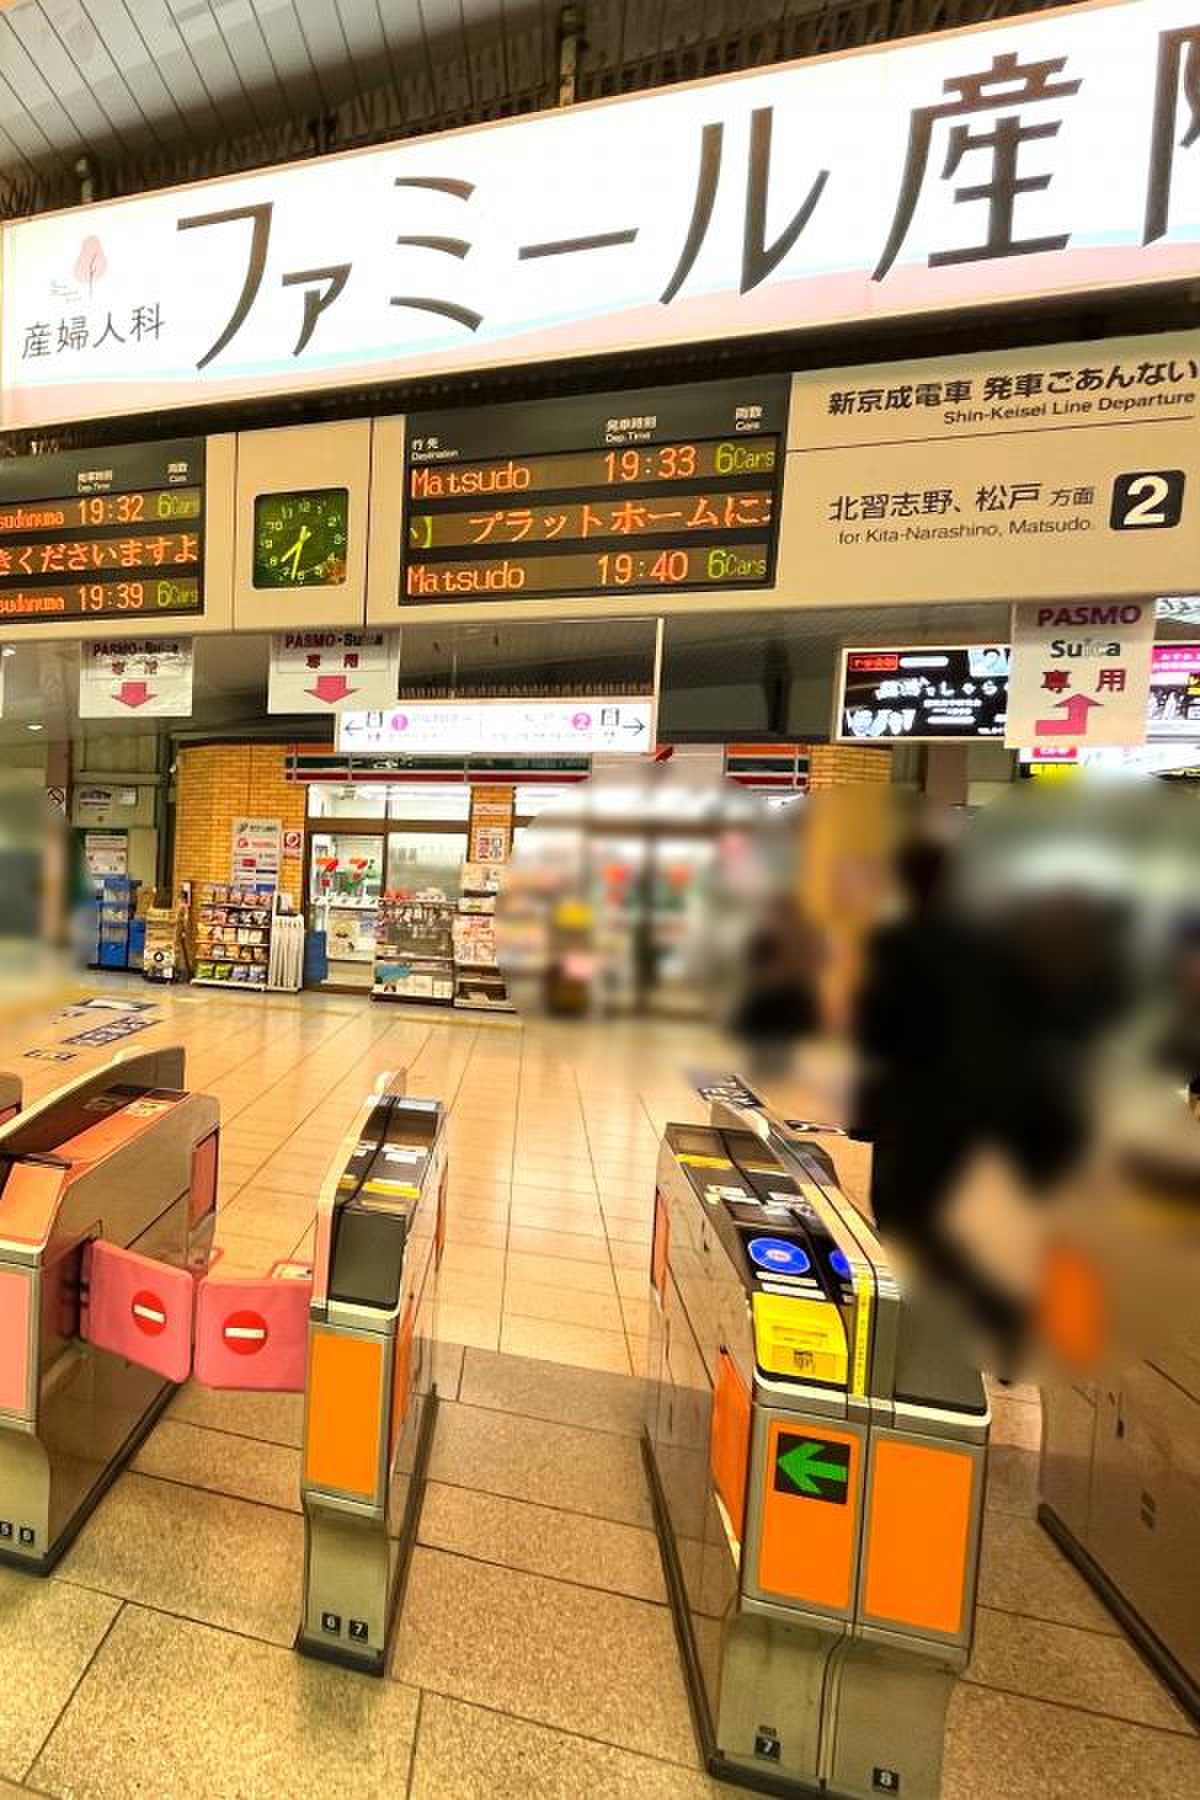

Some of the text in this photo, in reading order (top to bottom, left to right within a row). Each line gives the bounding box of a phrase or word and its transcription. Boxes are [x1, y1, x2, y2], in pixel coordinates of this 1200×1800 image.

[22, 301, 167, 360] 産婦人科
[828, 359, 1199, 417] 新京成電車 発車ごあんない
[944, 389, 1196, 426] Shin-Keisei Line Departure
[410, 441, 775, 497] Matsudo 19:33 6Cars
[79, 495, 144, 526] 19:32
[829, 482, 1095, 522] 北習志野、松戸 方面
[1122, 474, 1170, 527] 2
[838, 529, 861, 546] for
[865, 522, 1002, 544] Kita-Narashino,
[407, 548, 767, 596] Matsudo 19:40 6Cars
[79, 583, 144, 611] 19:39
[1037, 604, 1142, 627] PASMO
